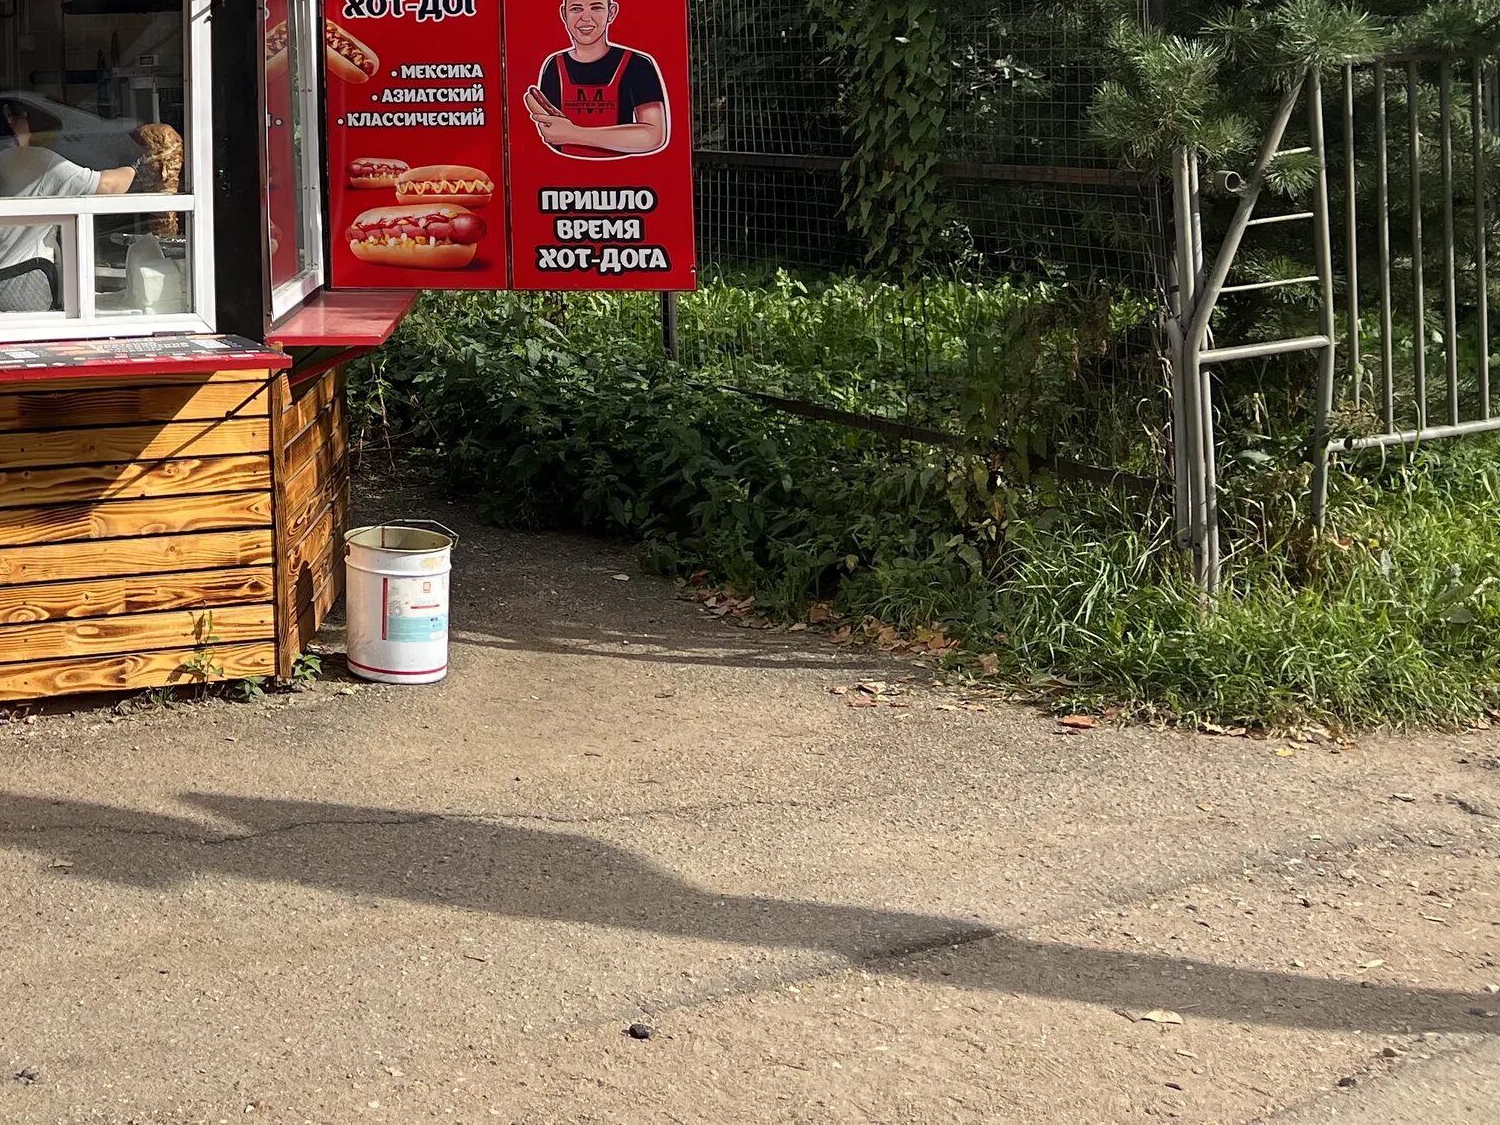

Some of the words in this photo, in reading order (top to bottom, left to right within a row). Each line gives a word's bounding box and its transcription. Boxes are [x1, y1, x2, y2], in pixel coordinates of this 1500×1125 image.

[401, 64, 483, 79] МЕКСИКА
[382, 83, 484, 103] АЗИАТСКИЙ
[347, 107, 484, 127] КЛАССИЧЕСКИЙ
[541, 190, 654, 211] ПРИШЛО
[556, 219, 640, 239] ВРЕМЯ
[538, 248, 668, 273] ХОТ-ДОГА
